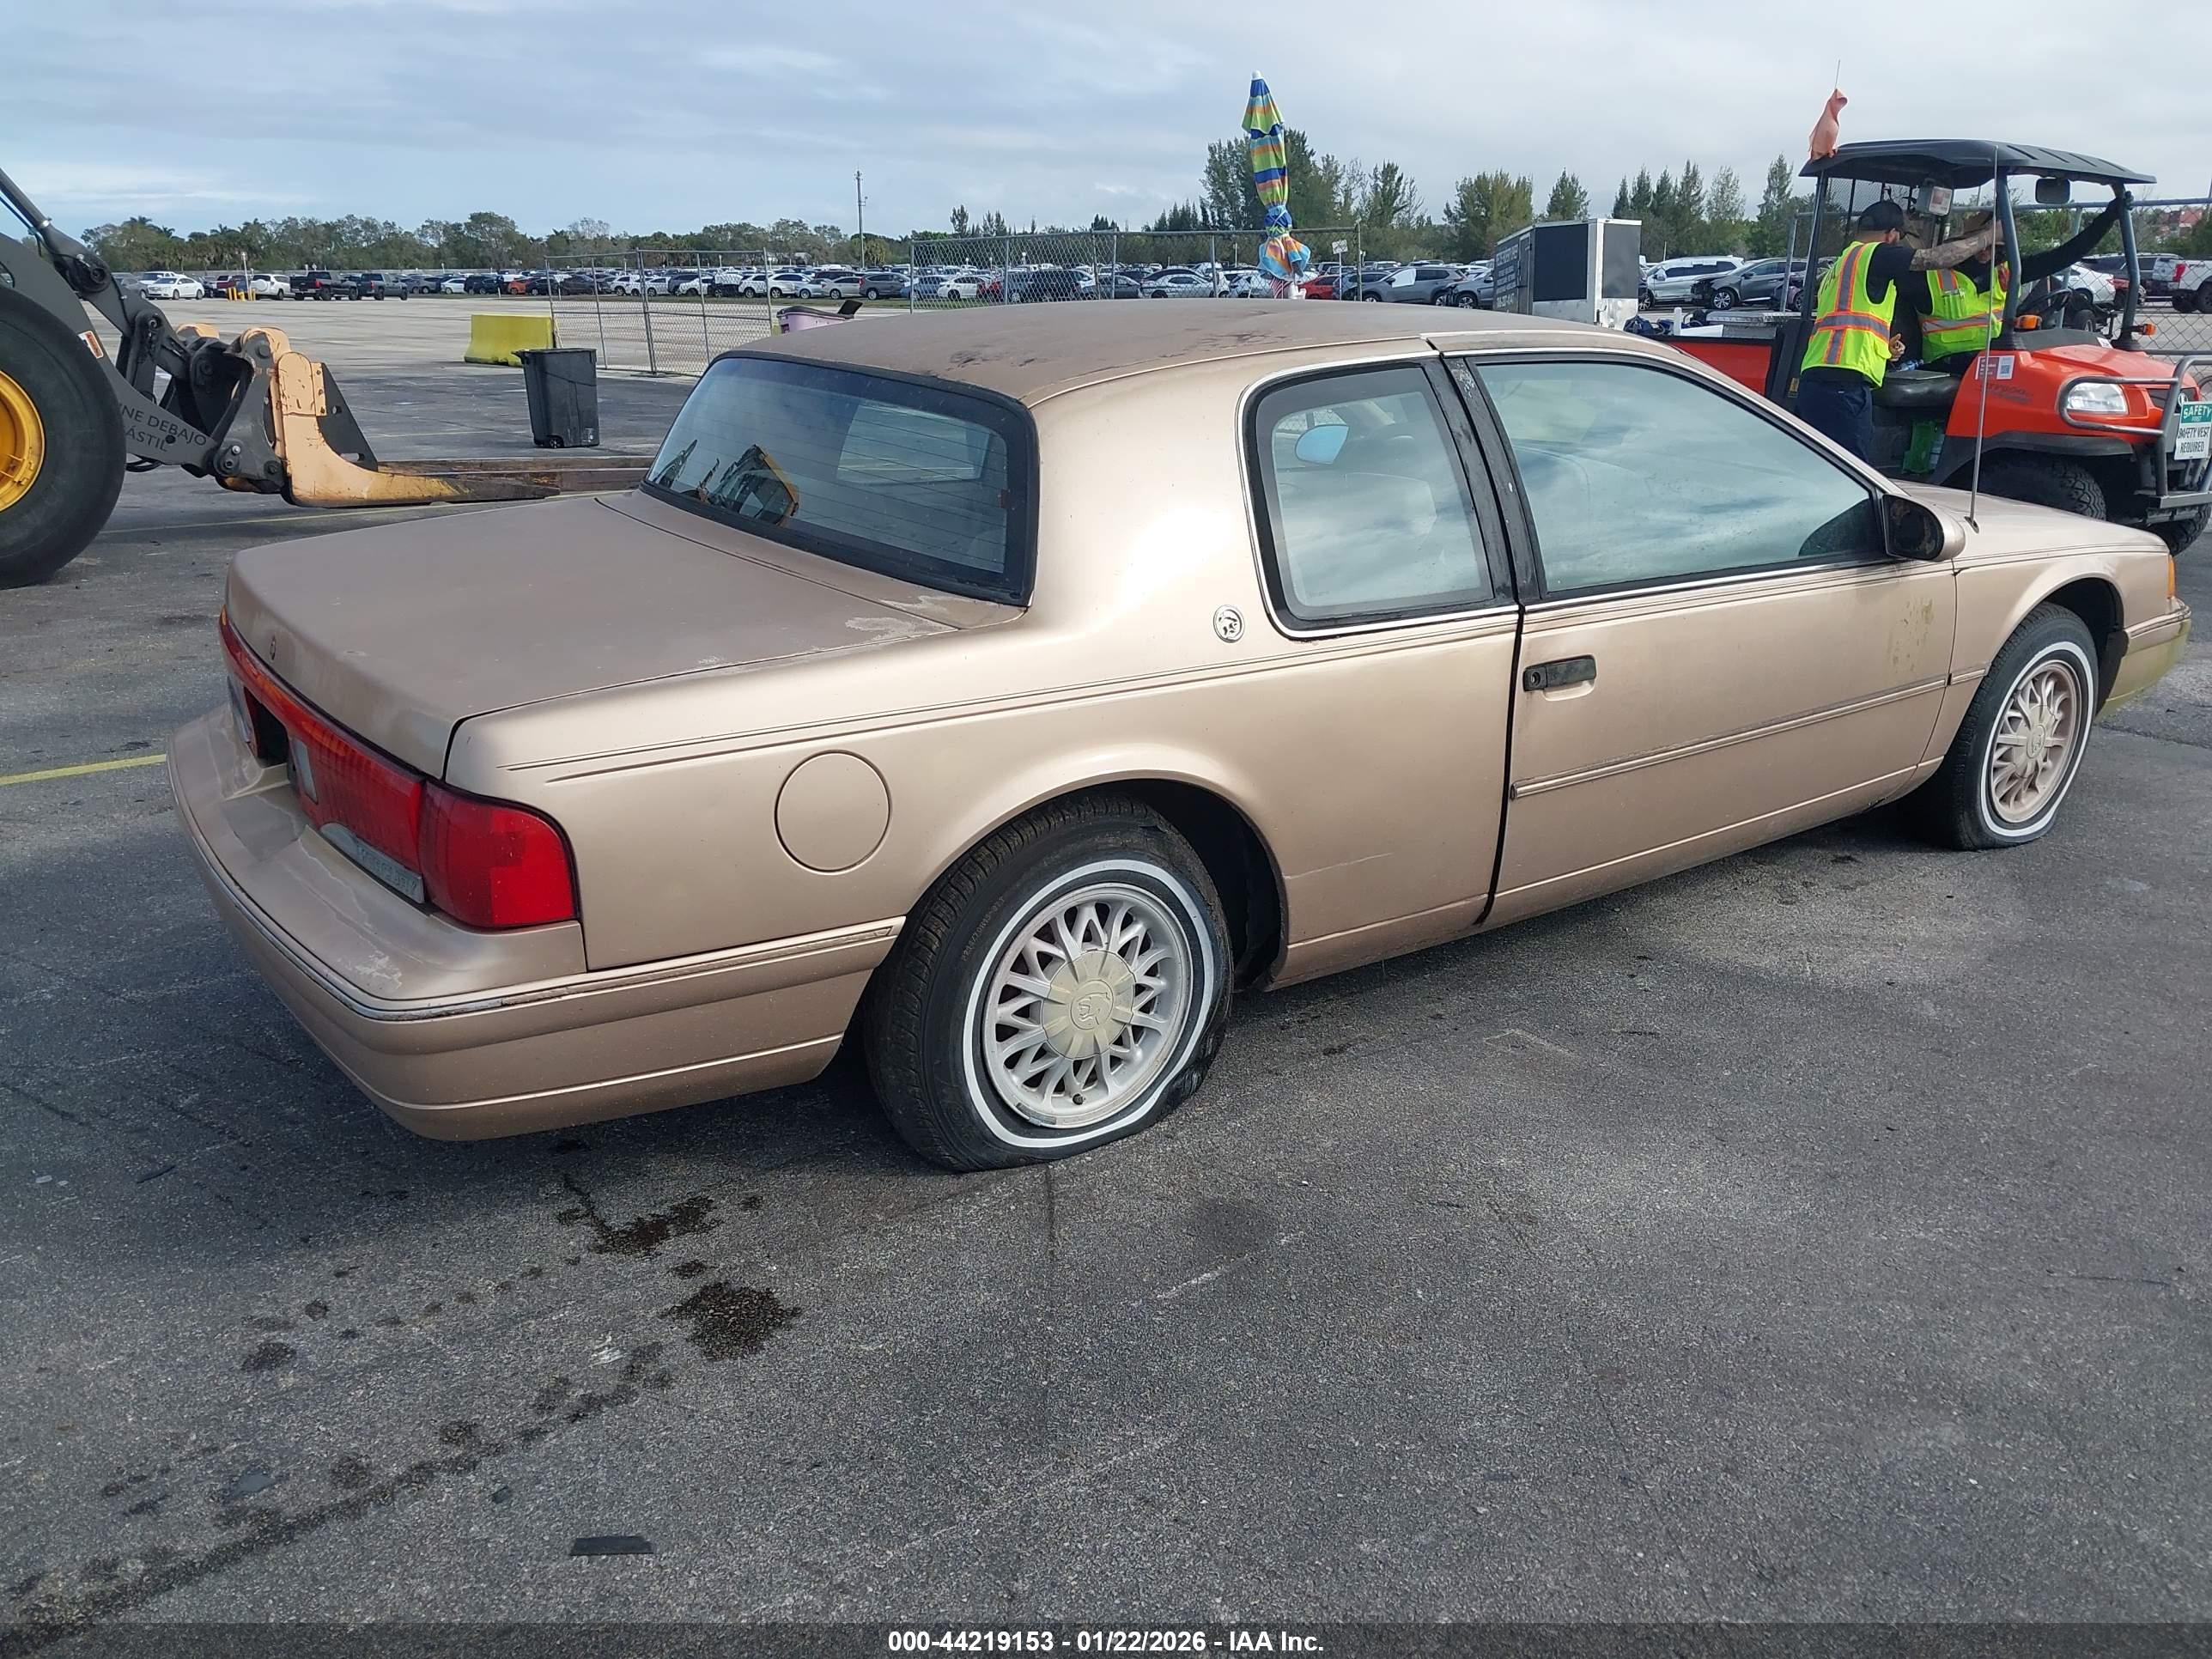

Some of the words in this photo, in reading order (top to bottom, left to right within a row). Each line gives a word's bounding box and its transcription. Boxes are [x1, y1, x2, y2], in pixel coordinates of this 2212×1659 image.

[2184, 404, 2212, 419] SAFETY
[118, 404, 144, 422] NE
[148, 416, 207, 447] DEBAJO
[2178, 427, 2197, 439] SAFETY
[2197, 426, 2210, 438] VEST
[125, 425, 168, 453] ÁSTIL
[2180, 441, 2205, 453] REQUIRED
